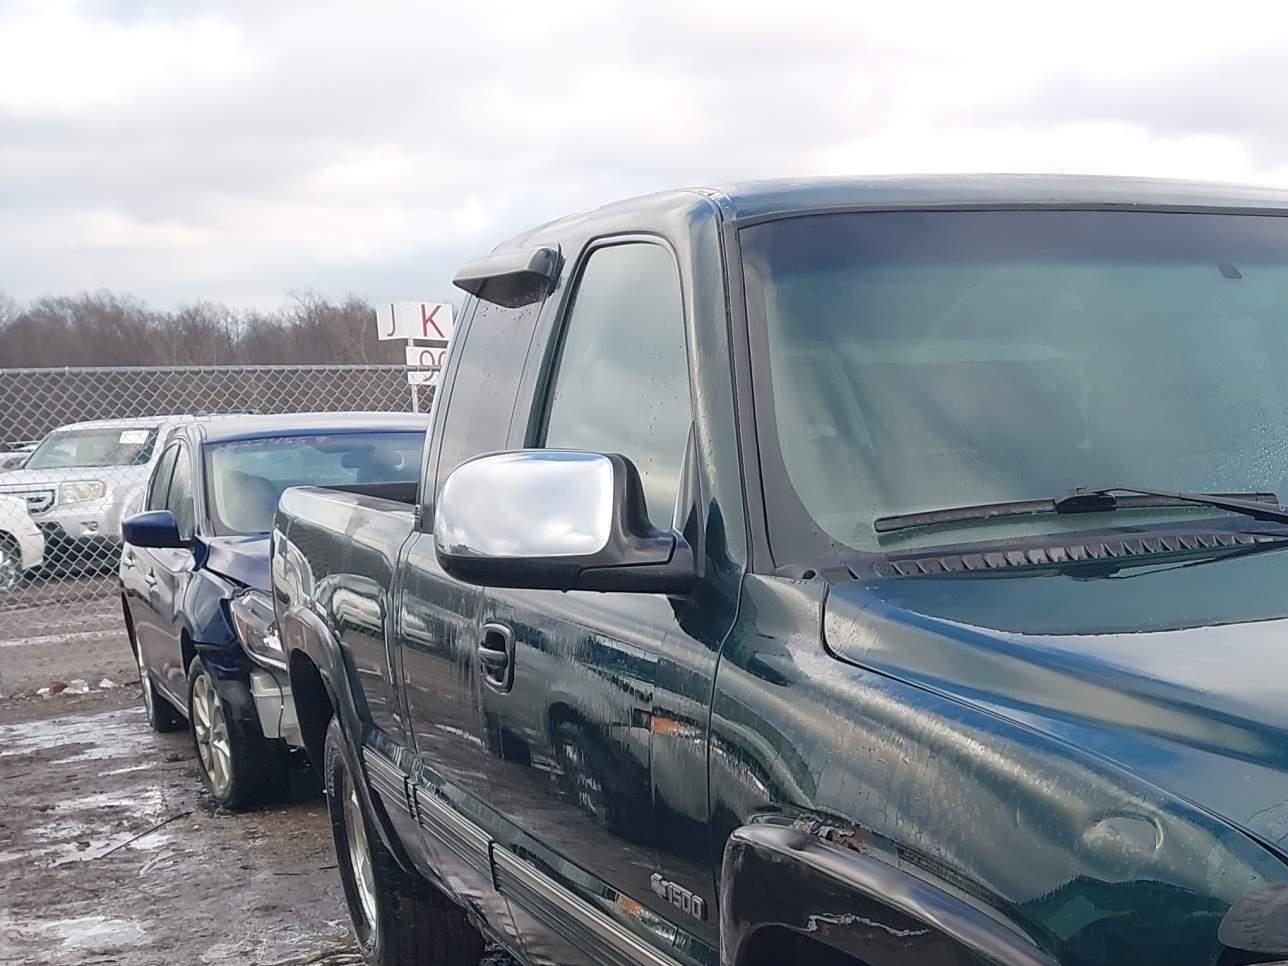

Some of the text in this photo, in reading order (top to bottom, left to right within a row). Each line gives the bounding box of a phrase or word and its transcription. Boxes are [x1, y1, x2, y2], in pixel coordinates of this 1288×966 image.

[387, 303, 445, 338] J K
[666, 881, 706, 921] 1500
